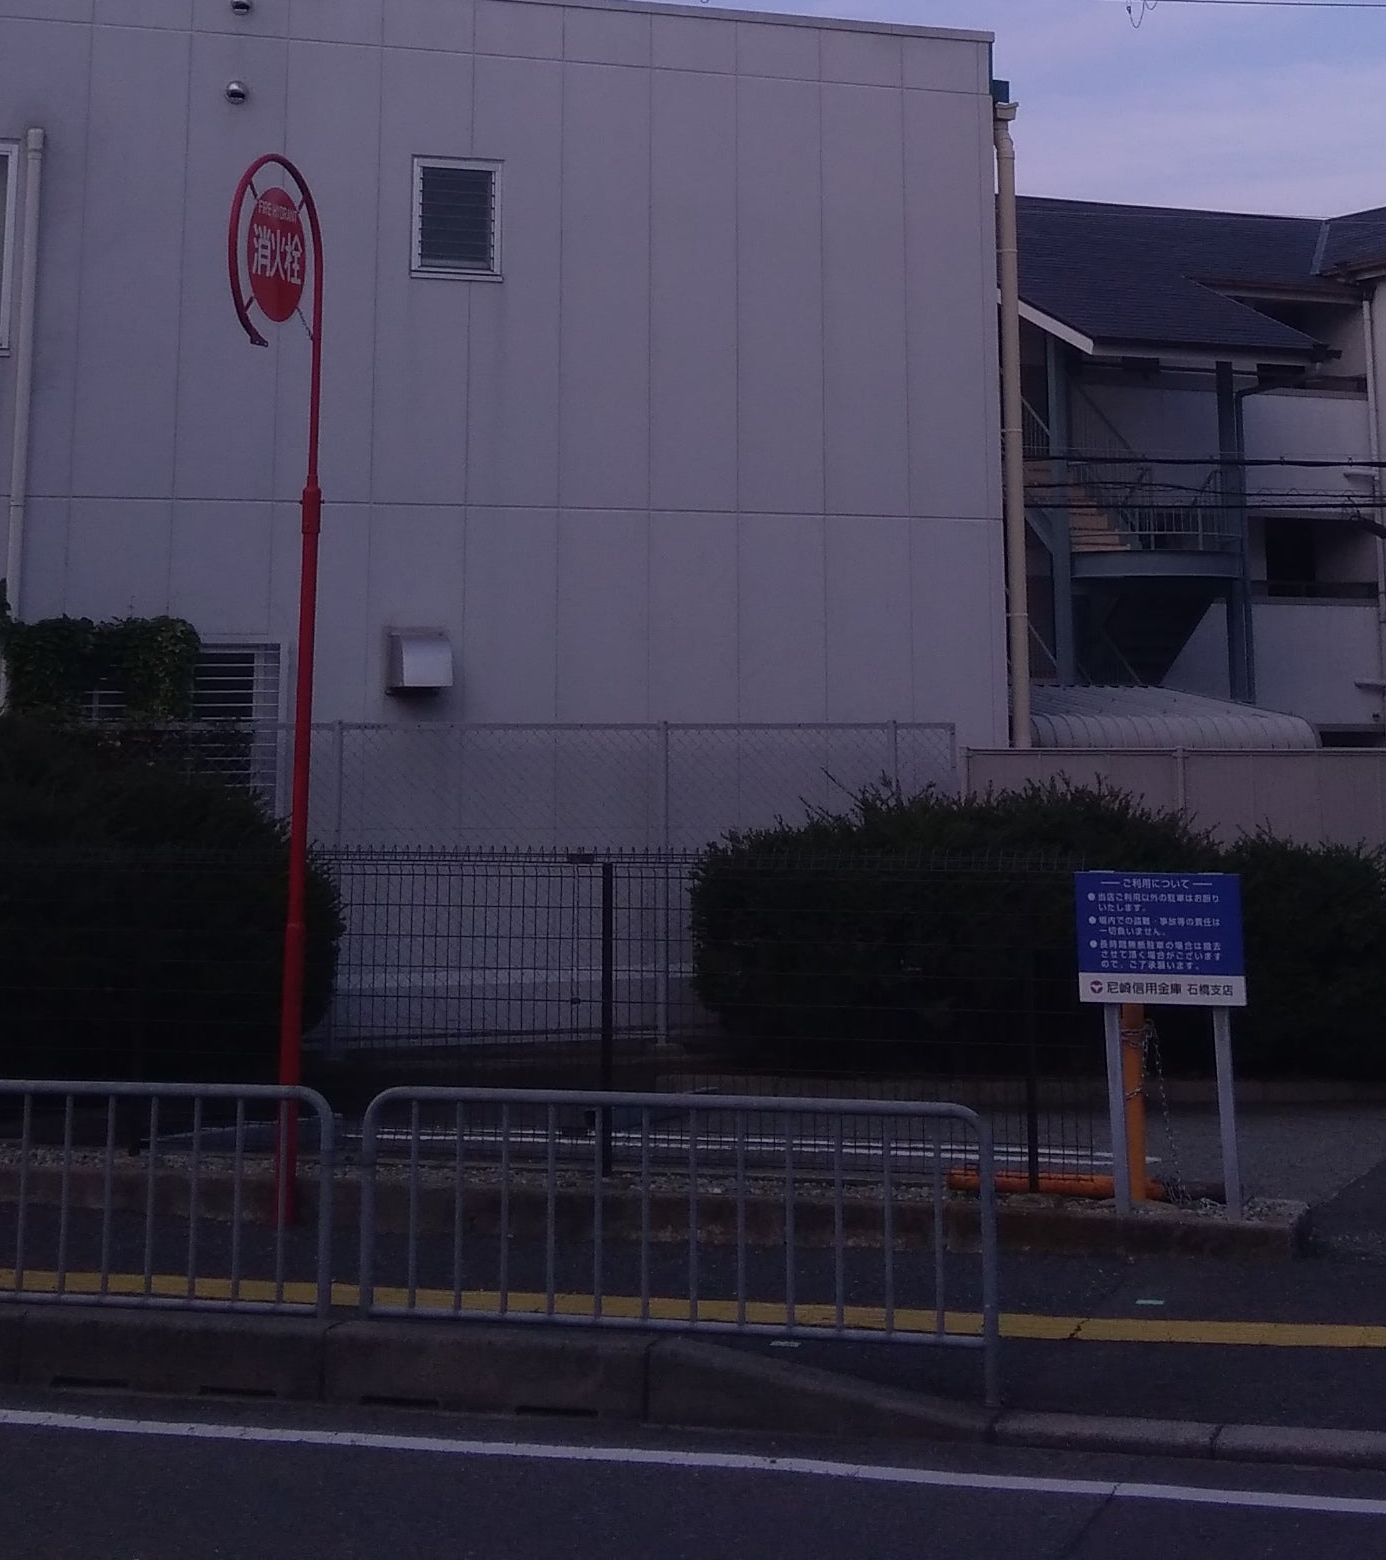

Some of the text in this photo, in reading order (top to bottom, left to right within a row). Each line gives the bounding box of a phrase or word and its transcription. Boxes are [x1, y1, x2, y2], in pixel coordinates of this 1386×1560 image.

[252, 223, 303, 285] 消火栓
[1123, 878, 1190, 890] ご利用について
[1107, 981, 1234, 996] 尼崎信用金庫 石橋支店
